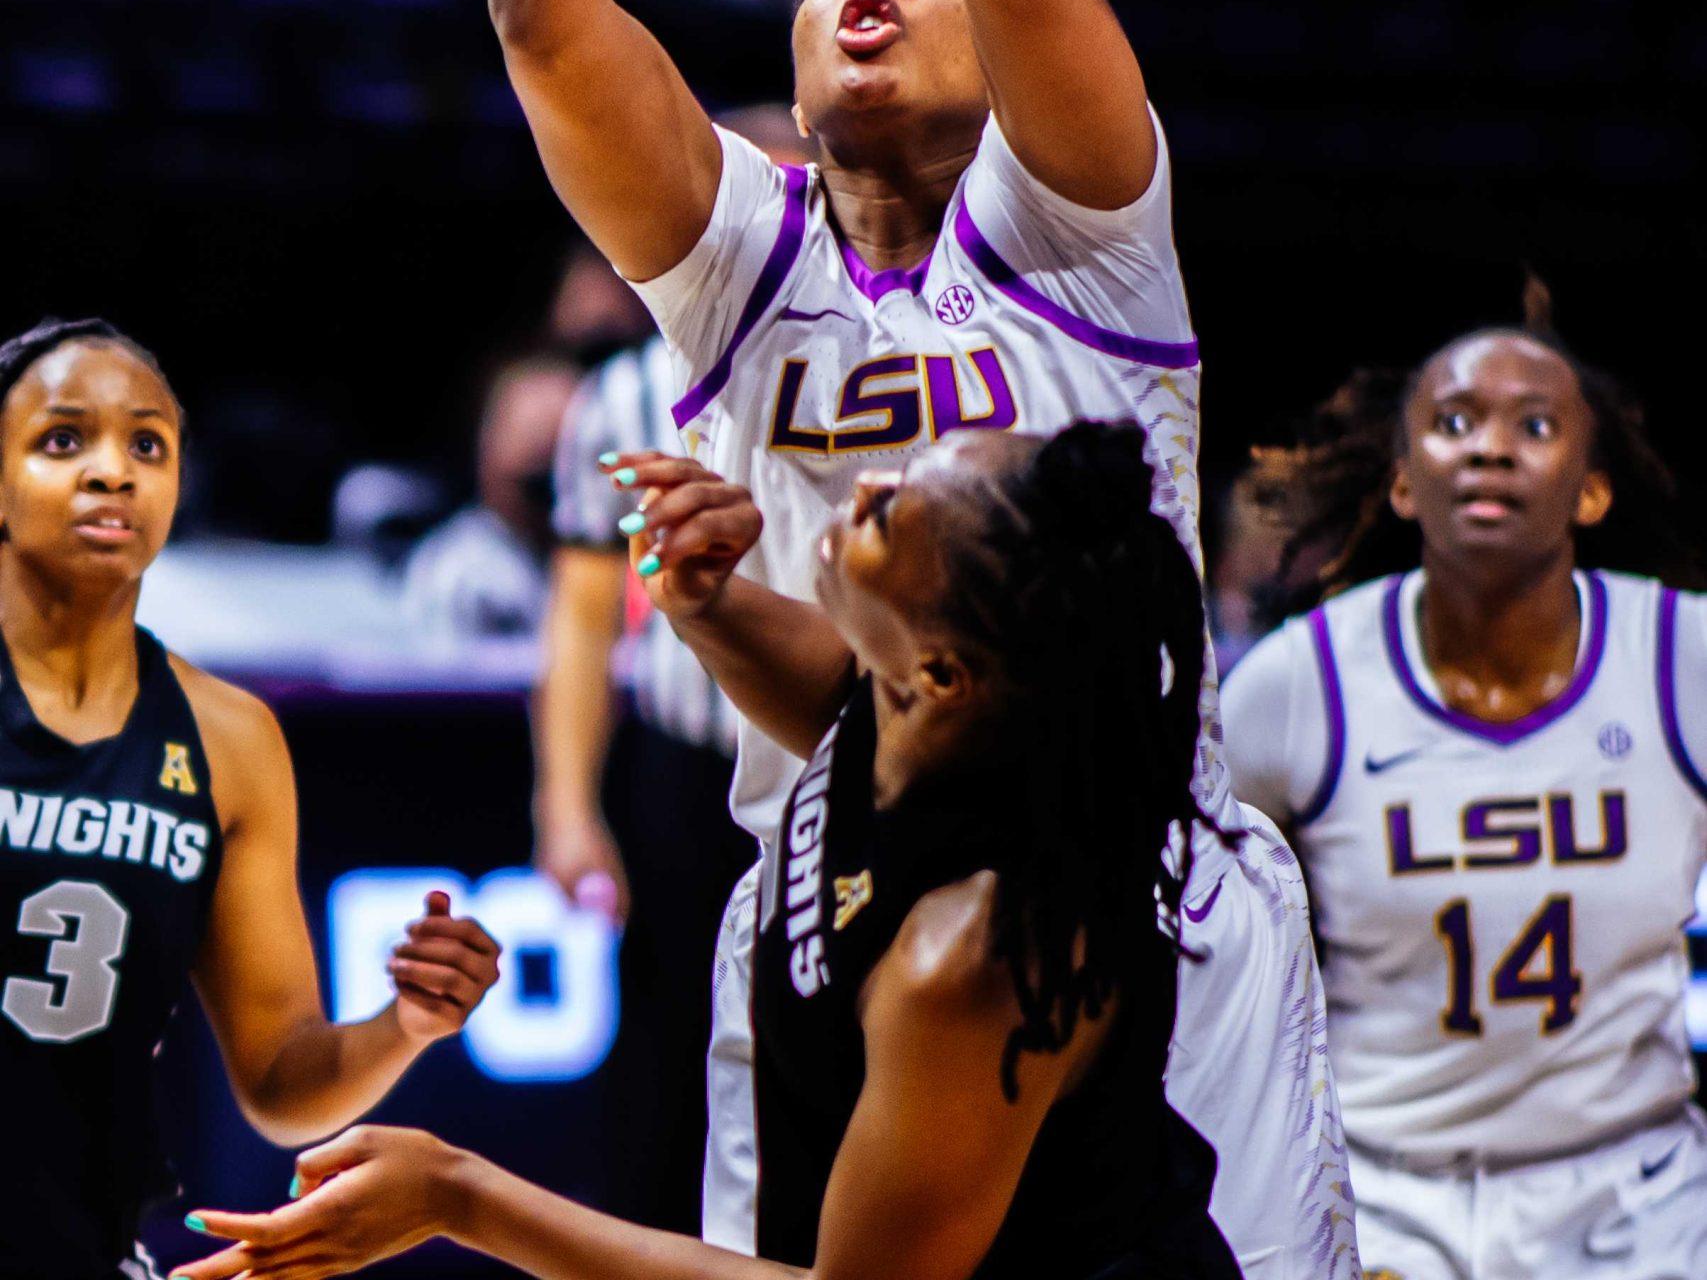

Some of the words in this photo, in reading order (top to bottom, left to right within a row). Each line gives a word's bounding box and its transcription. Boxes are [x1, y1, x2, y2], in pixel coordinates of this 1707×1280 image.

[936, 285, 975, 325] SEC
[767, 346, 1018, 454] LSU
[158, 742, 198, 795] A
[786, 703, 850, 997] NIGHTS
[1384, 791, 1629, 877] LSU
[1, 880, 128, 1043] 3
[1436, 893, 1584, 1038] 14
